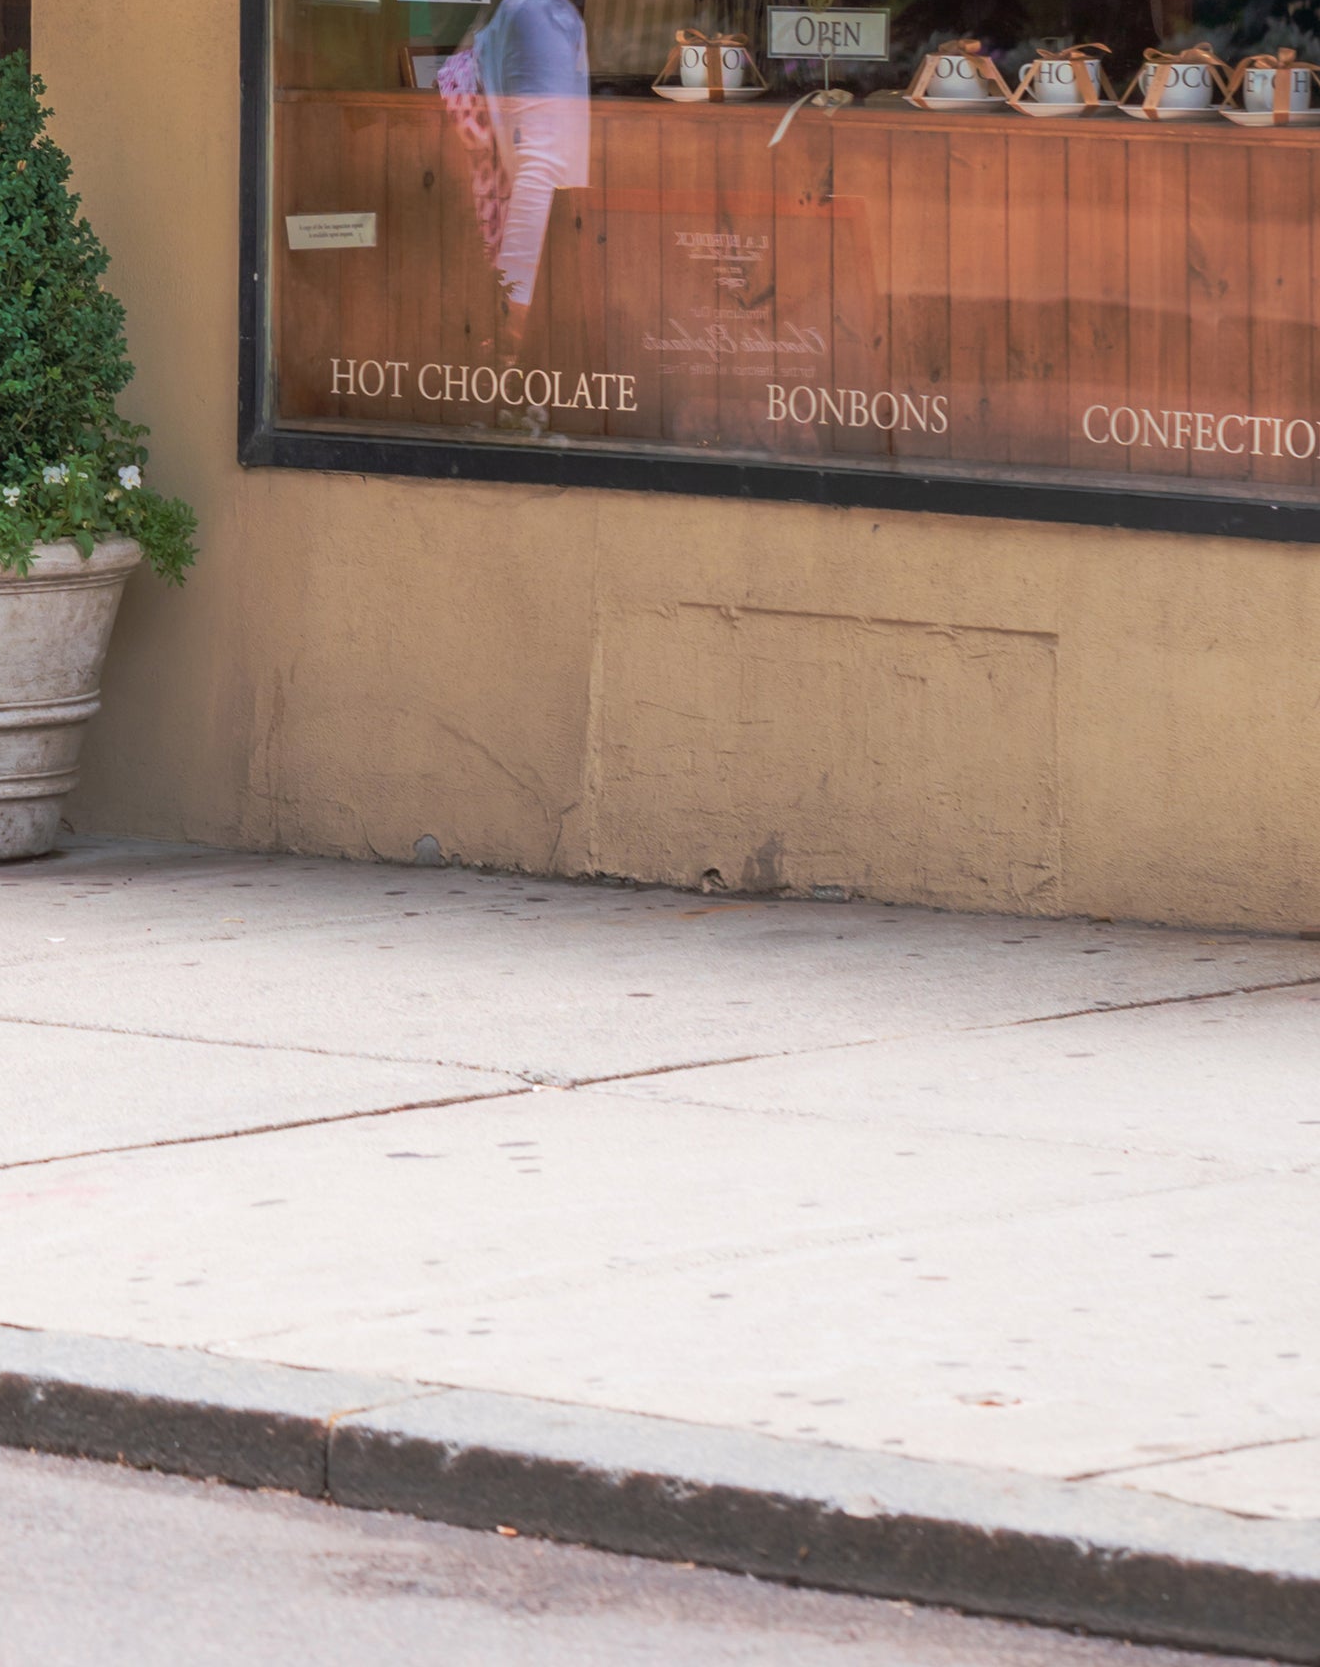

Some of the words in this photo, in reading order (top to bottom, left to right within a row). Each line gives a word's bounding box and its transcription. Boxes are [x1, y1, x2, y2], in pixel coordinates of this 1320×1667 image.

[330, 358, 409, 398] HOT
[418, 364, 638, 412] CHOCOLATE
[765, 383, 949, 434] BONBONS
[1082, 404, 1320, 460] CONFECTIO
